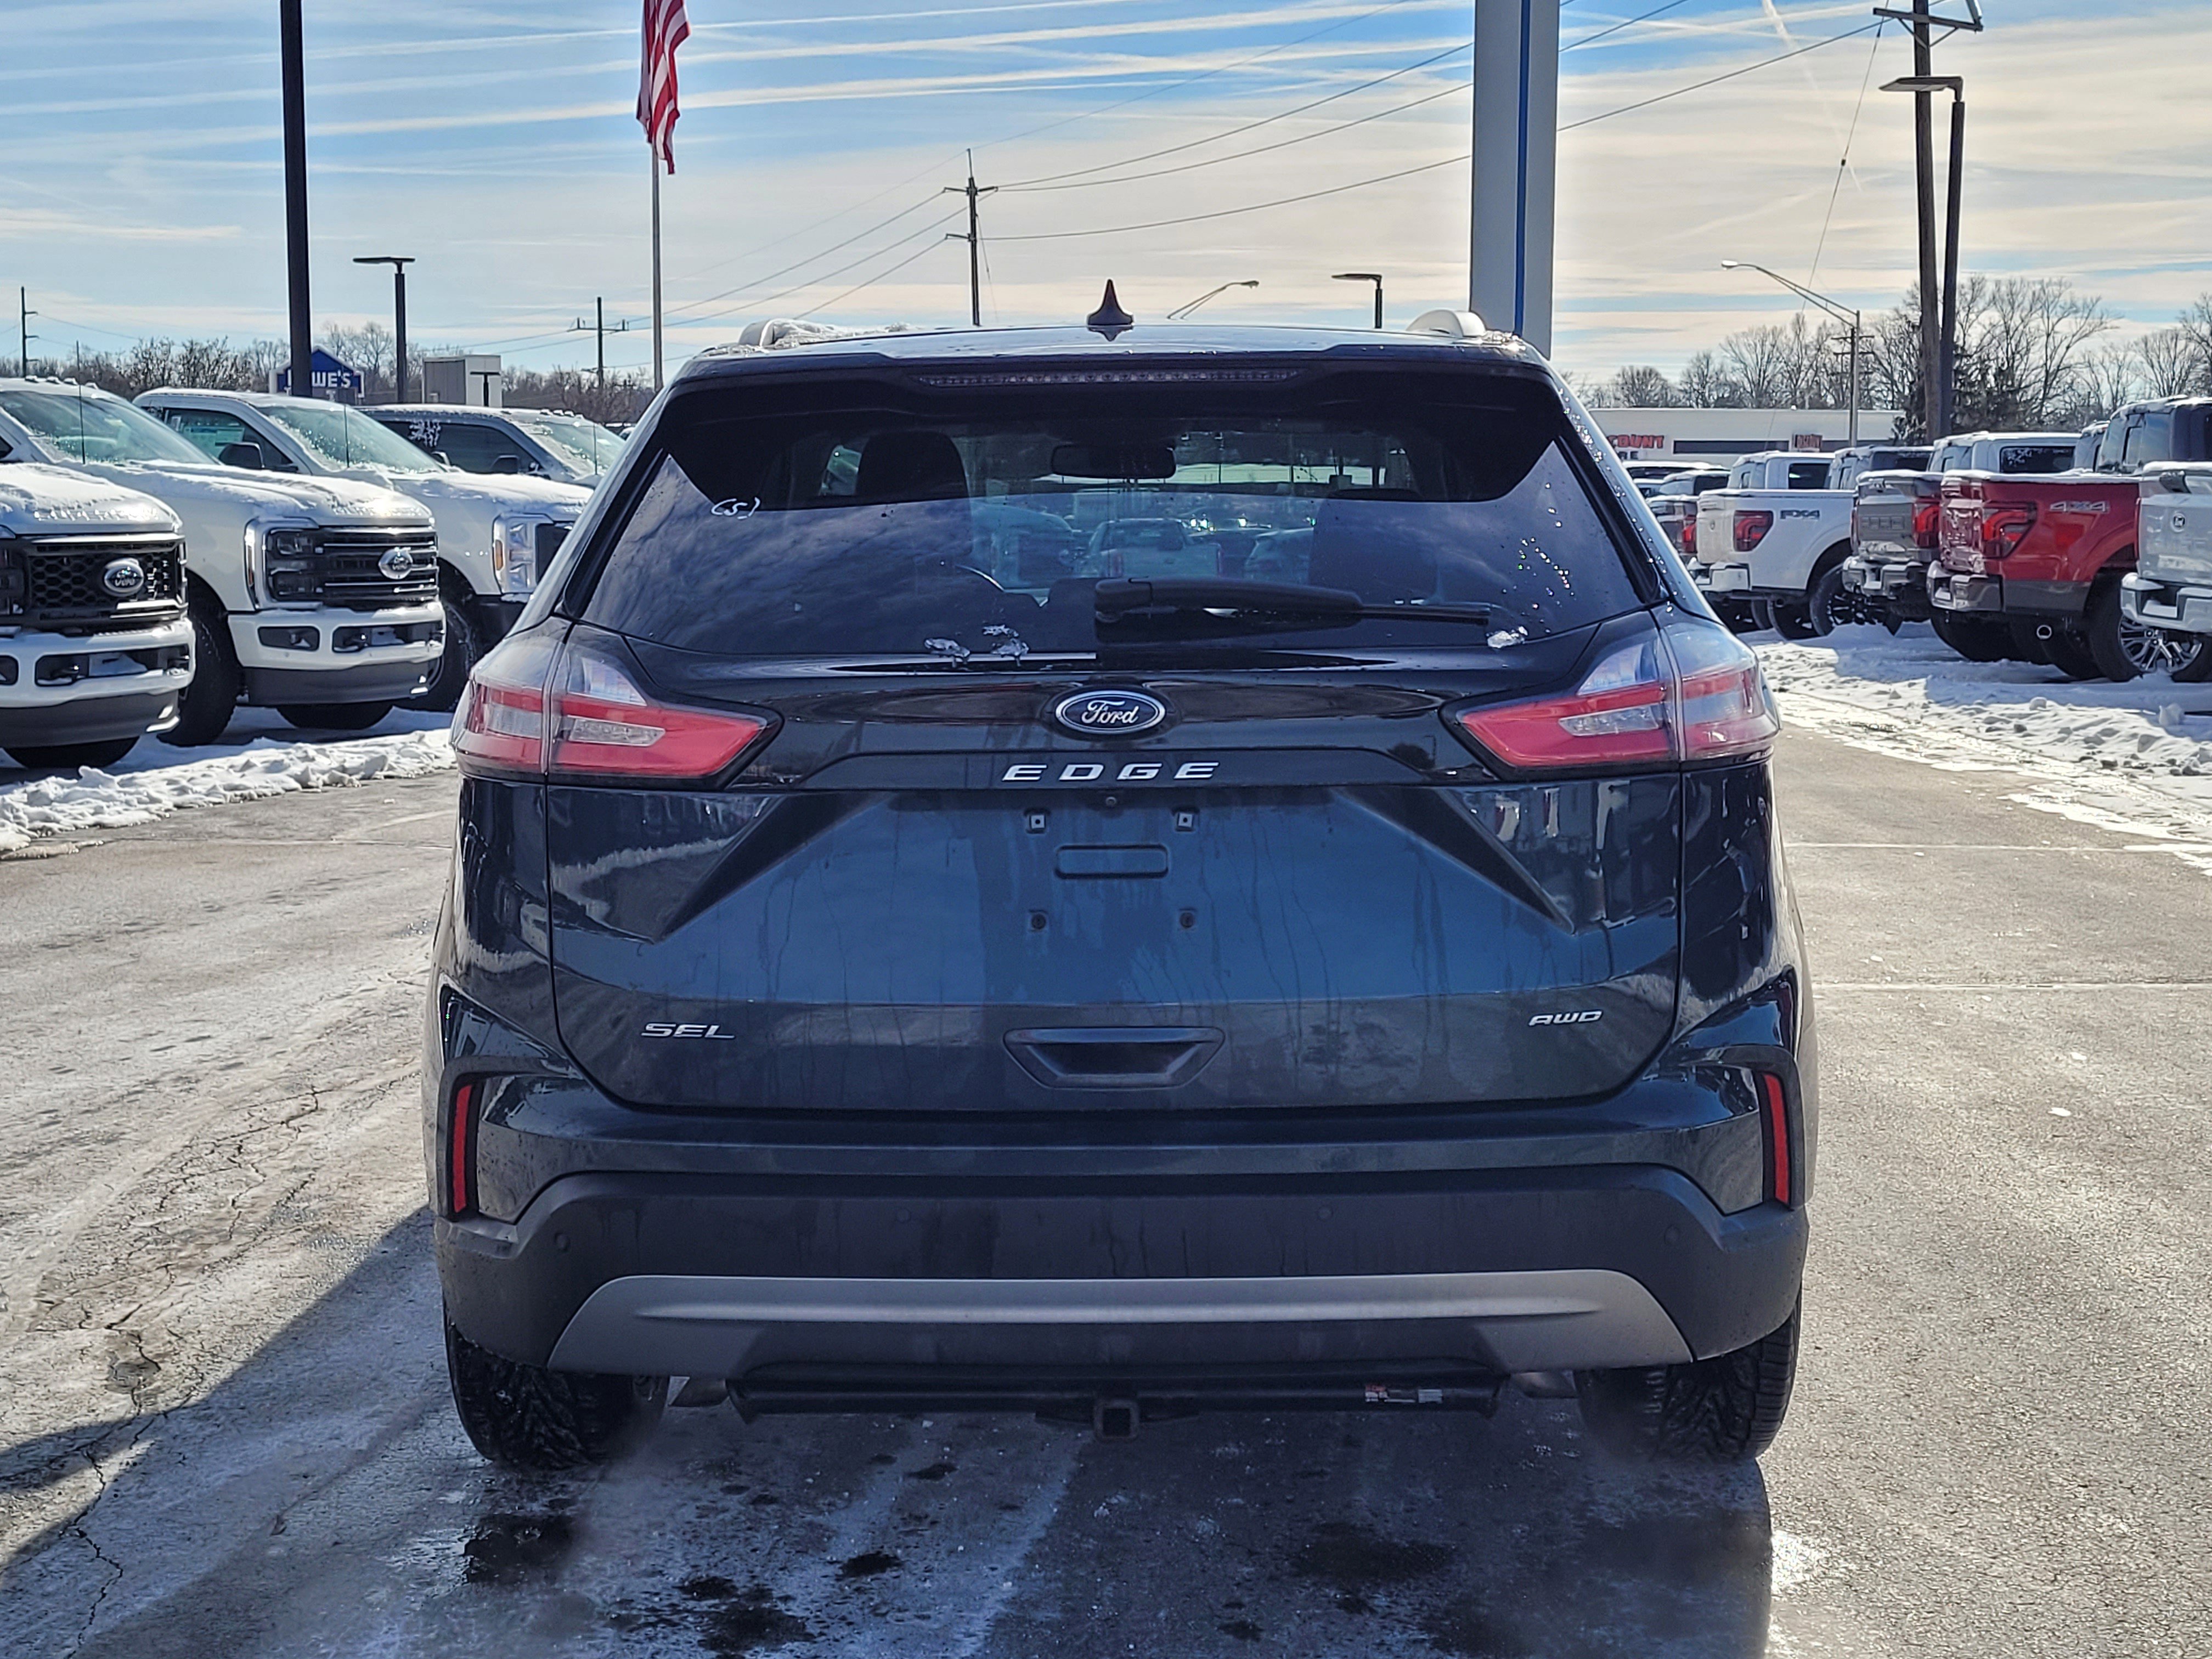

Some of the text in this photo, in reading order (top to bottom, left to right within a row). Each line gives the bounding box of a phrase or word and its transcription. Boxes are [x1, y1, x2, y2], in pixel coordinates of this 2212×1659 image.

[1081, 699, 1139, 724] Ford
[1002, 762, 1219, 781] EDGE
[1528, 1010, 1602, 1026] AWD
[641, 1023, 735, 1039] SEL
